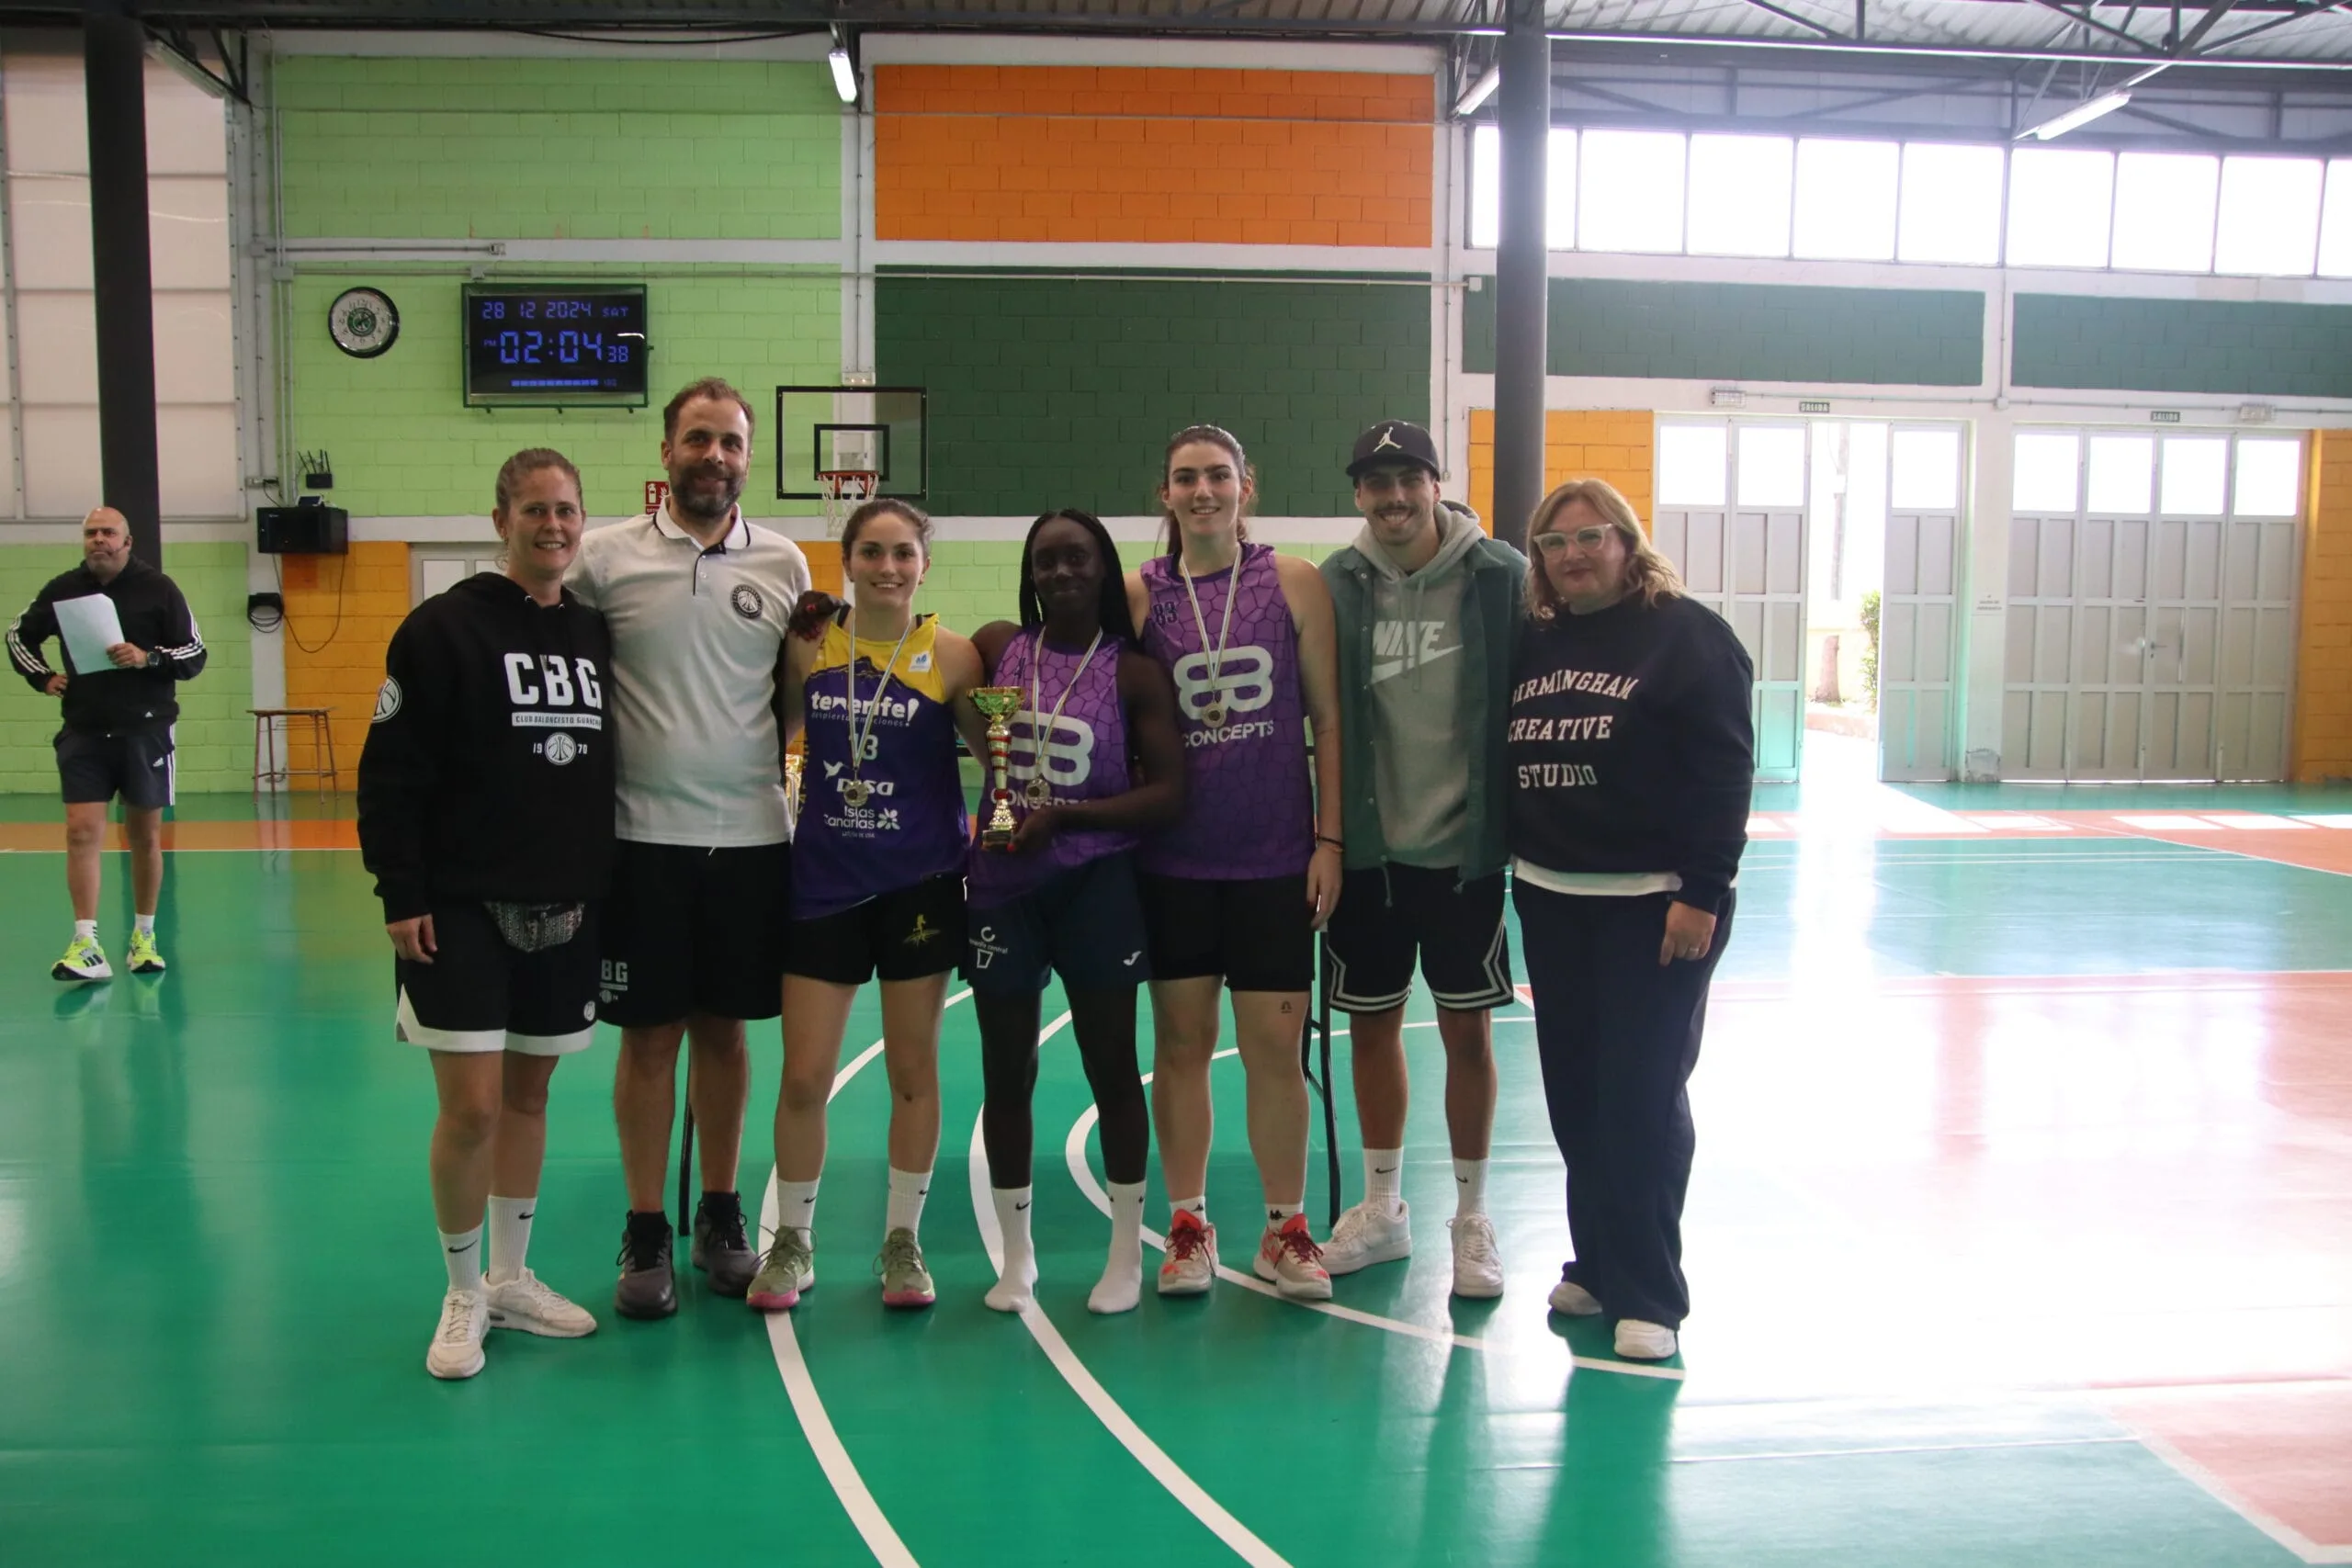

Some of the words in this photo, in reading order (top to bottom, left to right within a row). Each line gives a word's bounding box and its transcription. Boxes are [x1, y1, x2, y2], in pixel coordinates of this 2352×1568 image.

[482, 301, 505, 320] 28
[520, 301, 536, 319] 12
[546, 301, 592, 318] 2024
[602, 307, 628, 317] SAT
[500, 331, 602, 363] 02:04
[607, 345, 628, 363] 38
[503, 653, 602, 710] CBG
[1508, 716, 1613, 742] CREATIVE
[1518, 763, 1598, 789] STUDIO
